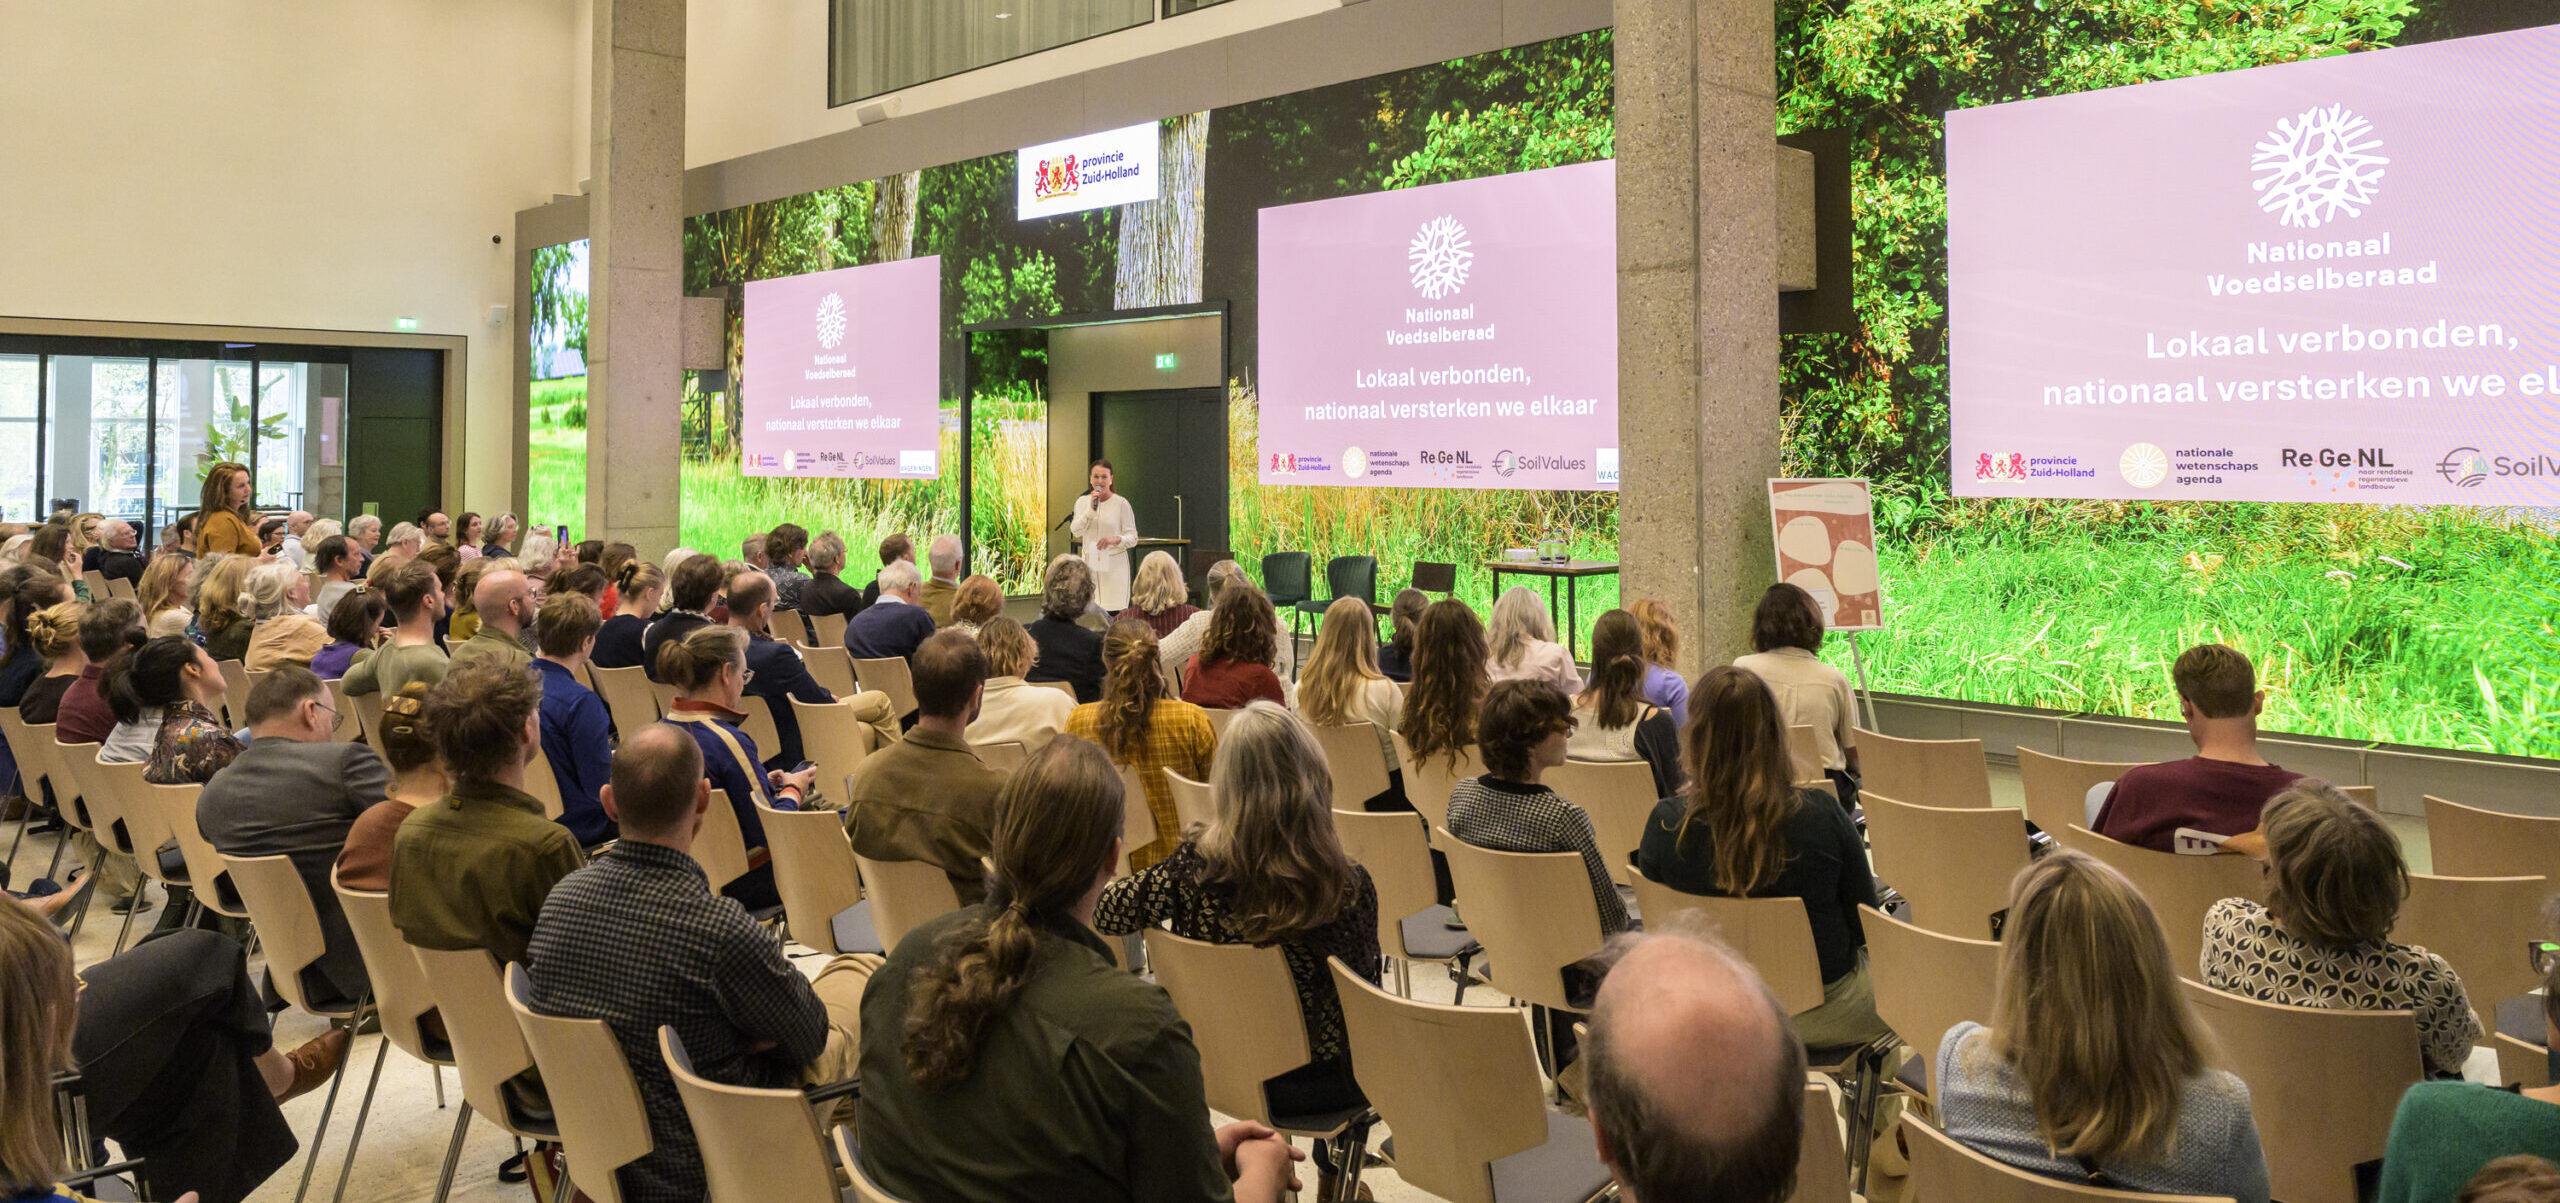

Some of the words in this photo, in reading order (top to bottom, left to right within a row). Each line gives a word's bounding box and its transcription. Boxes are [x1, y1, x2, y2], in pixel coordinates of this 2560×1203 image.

[1082, 150, 1124, 170] provincie
[1082, 163, 1140, 185] Zuid-Holland
[2247, 232, 2390, 264] Nationaal
[2207, 260, 2437, 296] Voedselberaad
[1405, 303, 1474, 324] Nationaal
[1386, 323, 1495, 345] Voedselberaad
[2146, 327, 2269, 359] Lokaal
[2277, 319, 2519, 354] verbonden,
[814, 353, 847, 365] Nationaal
[805, 367, 856, 380] Voedselberaad
[1356, 367, 1416, 389] Lokaal
[1420, 363, 1531, 386] verbonden,
[2043, 376, 2208, 406] nationaal
[2216, 371, 2430, 402] versterken
[2441, 375, 2506, 397] we
[2518, 365, 2560, 396] el
[790, 395, 819, 409] Lokaal
[820, 394, 872, 408] verbonden,
[1305, 401, 1386, 420] nationaal
[1390, 398, 1491, 419] versterken
[1495, 399, 1525, 417] we
[1530, 395, 1598, 416] elkaar
[766, 418, 805, 431] nationaal
[806, 416, 854, 430] versterken
[855, 418, 870, 429] we
[871, 415, 902, 429] elkaar
[2175, 448, 2234, 457] nationale
[1518, 455, 1586, 471] SoilValues
[2030, 457, 2077, 468] provincie
[2175, 461, 2259, 472] wetenschaps
[2030, 468, 2095, 478] Zuid-Holland
[2176, 475, 2223, 486] agenda
